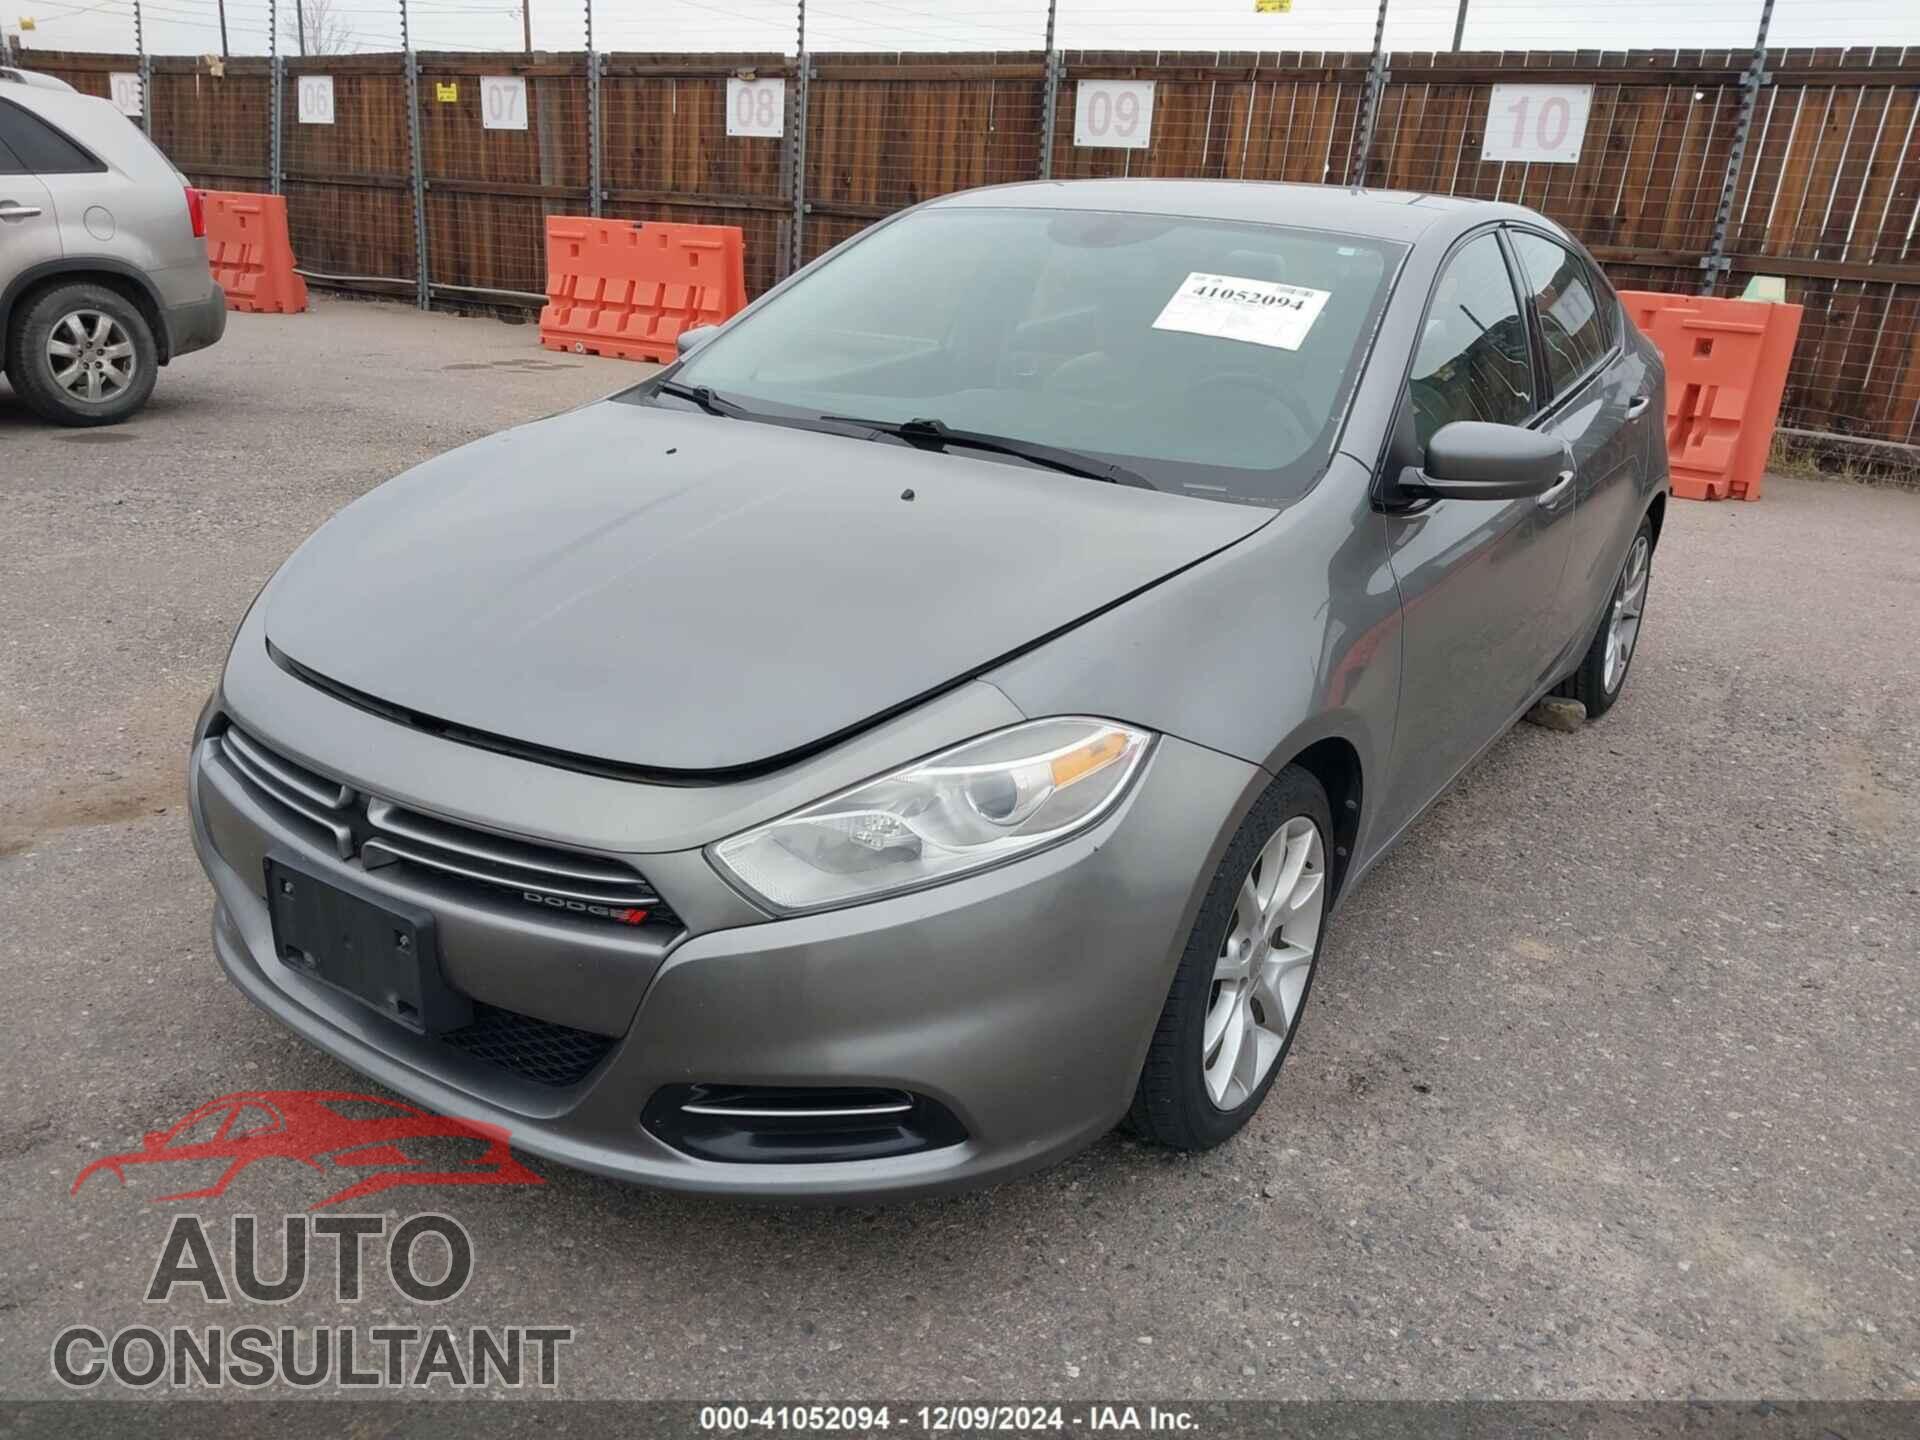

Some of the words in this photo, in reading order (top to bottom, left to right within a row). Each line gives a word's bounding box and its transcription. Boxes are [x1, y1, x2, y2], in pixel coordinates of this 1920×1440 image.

[304, 83, 330, 117] 06
[489, 85, 520, 121] 07
[737, 87, 774, 127] 08
[1087, 91, 1140, 137] 09
[1504, 95, 1570, 150] 10
[1192, 285, 1305, 312] 41052094
[523, 891, 628, 921] DODGE
